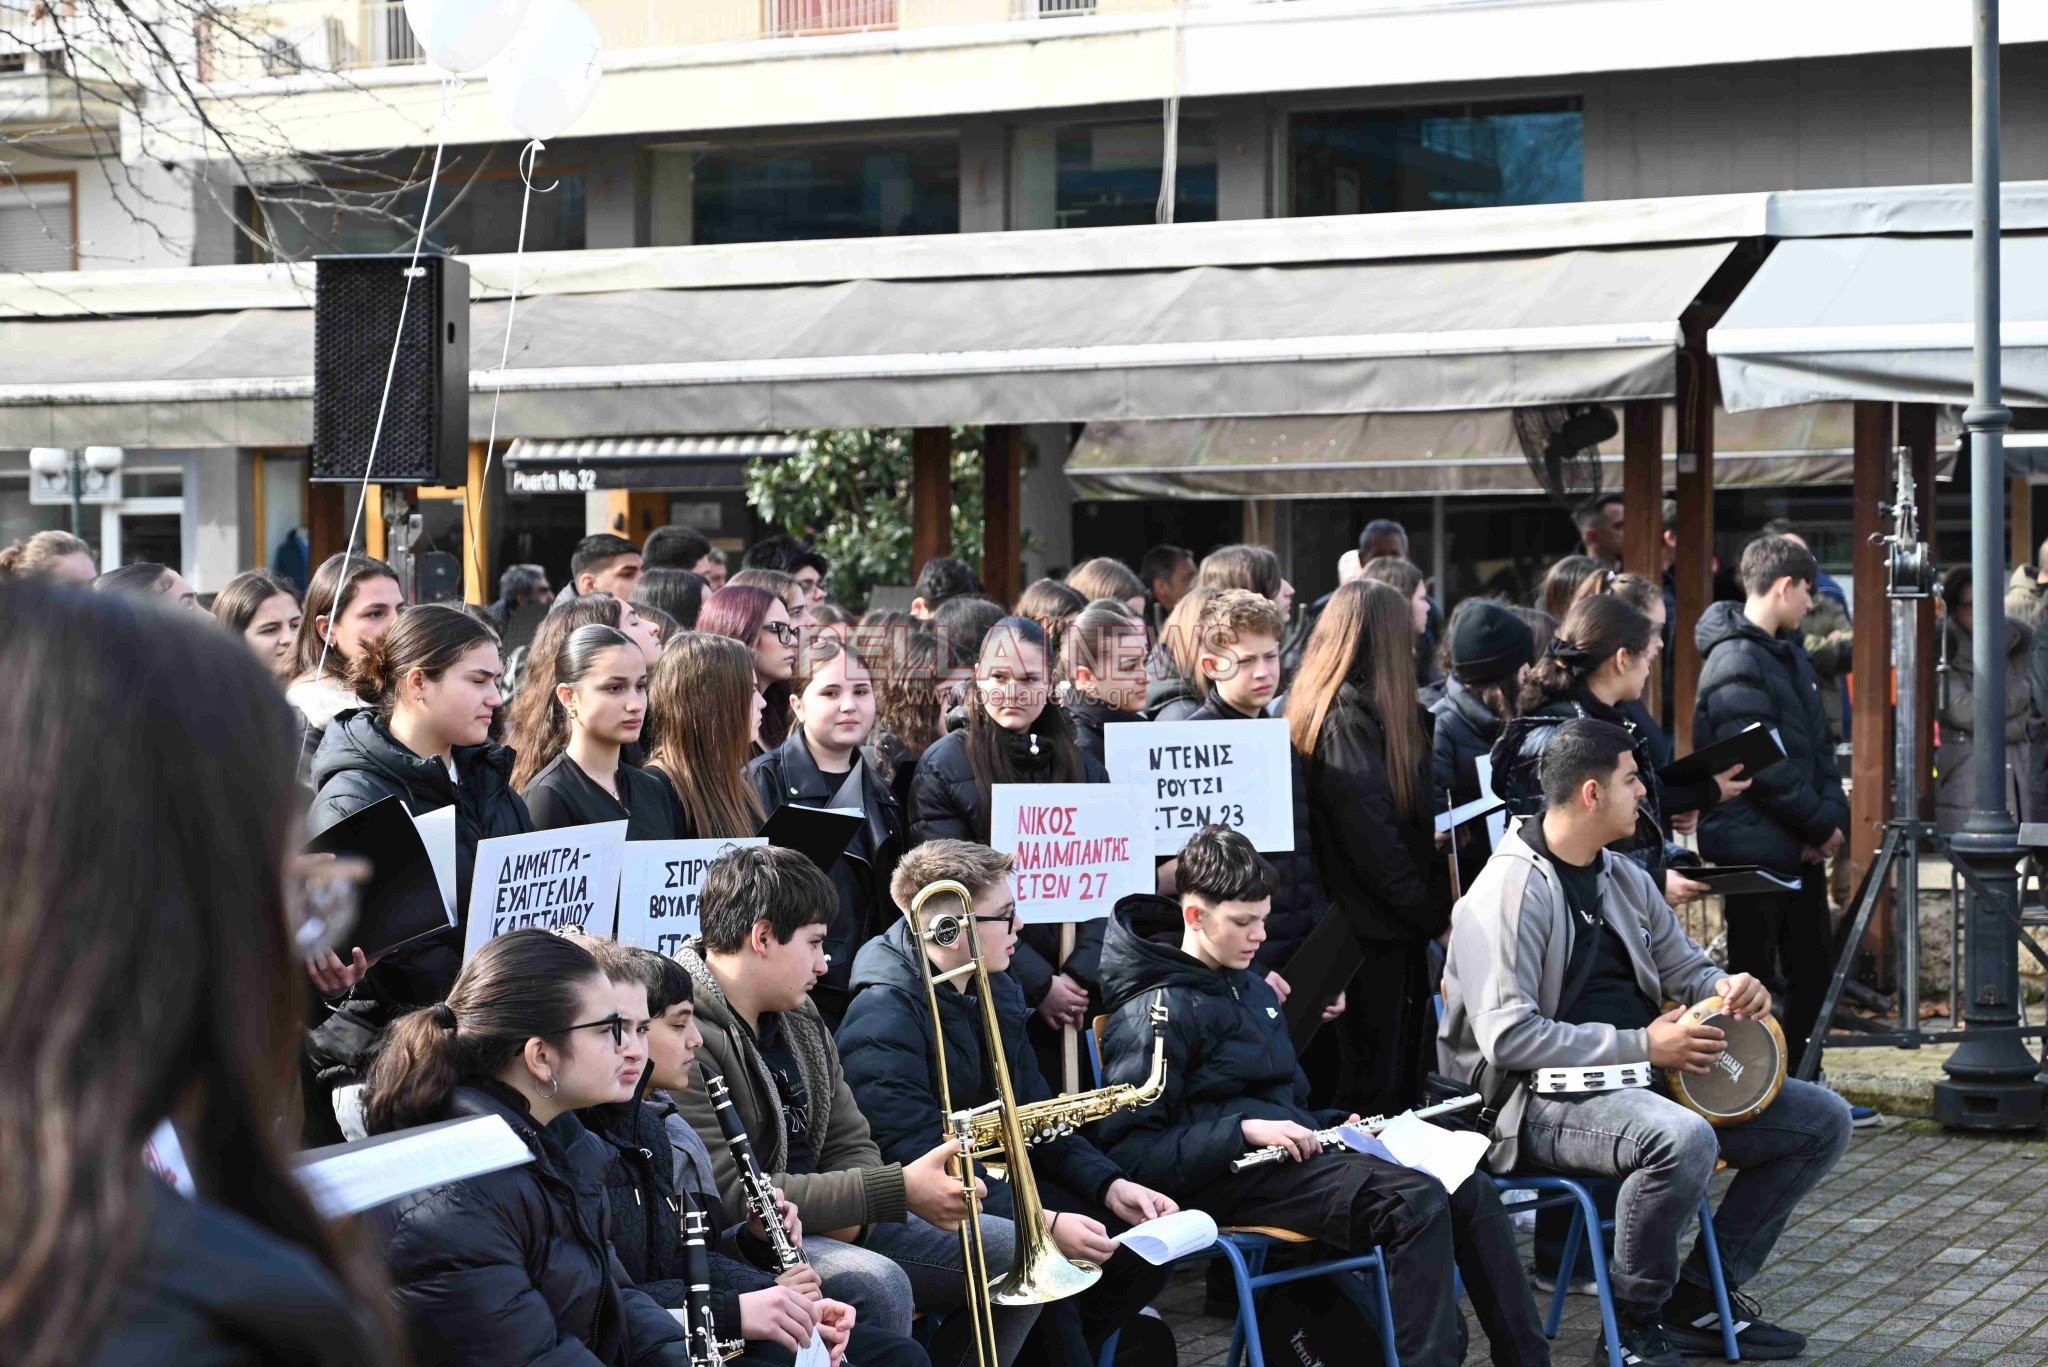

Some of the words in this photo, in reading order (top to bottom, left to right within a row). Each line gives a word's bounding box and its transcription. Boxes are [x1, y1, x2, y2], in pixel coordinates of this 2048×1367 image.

[513, 470, 558, 491] Puerta
[559, 469, 577, 491] No
[578, 468, 597, 491] 32
[1149, 744, 1233, 771] ΝΤΕΝΙΣ
[1157, 776, 1223, 799] ΡΟΥΤΣΙ
[1017, 805, 1078, 836] ΝΙΚΟΣ
[1155, 805, 1212, 830] ΤΩΝ
[1220, 804, 1245, 827] 23
[498, 847, 591, 884] ΔΗΜΗΤΡΑ-
[1016, 836, 1130, 871] ΝΑΛΜΠΑΝΤΗΣ
[496, 876, 587, 913] ΕΥΑΓΓΕΛΙΑ
[1017, 872, 1070, 901] ΕΤΩΝ
[1079, 872, 1108, 900] 27
